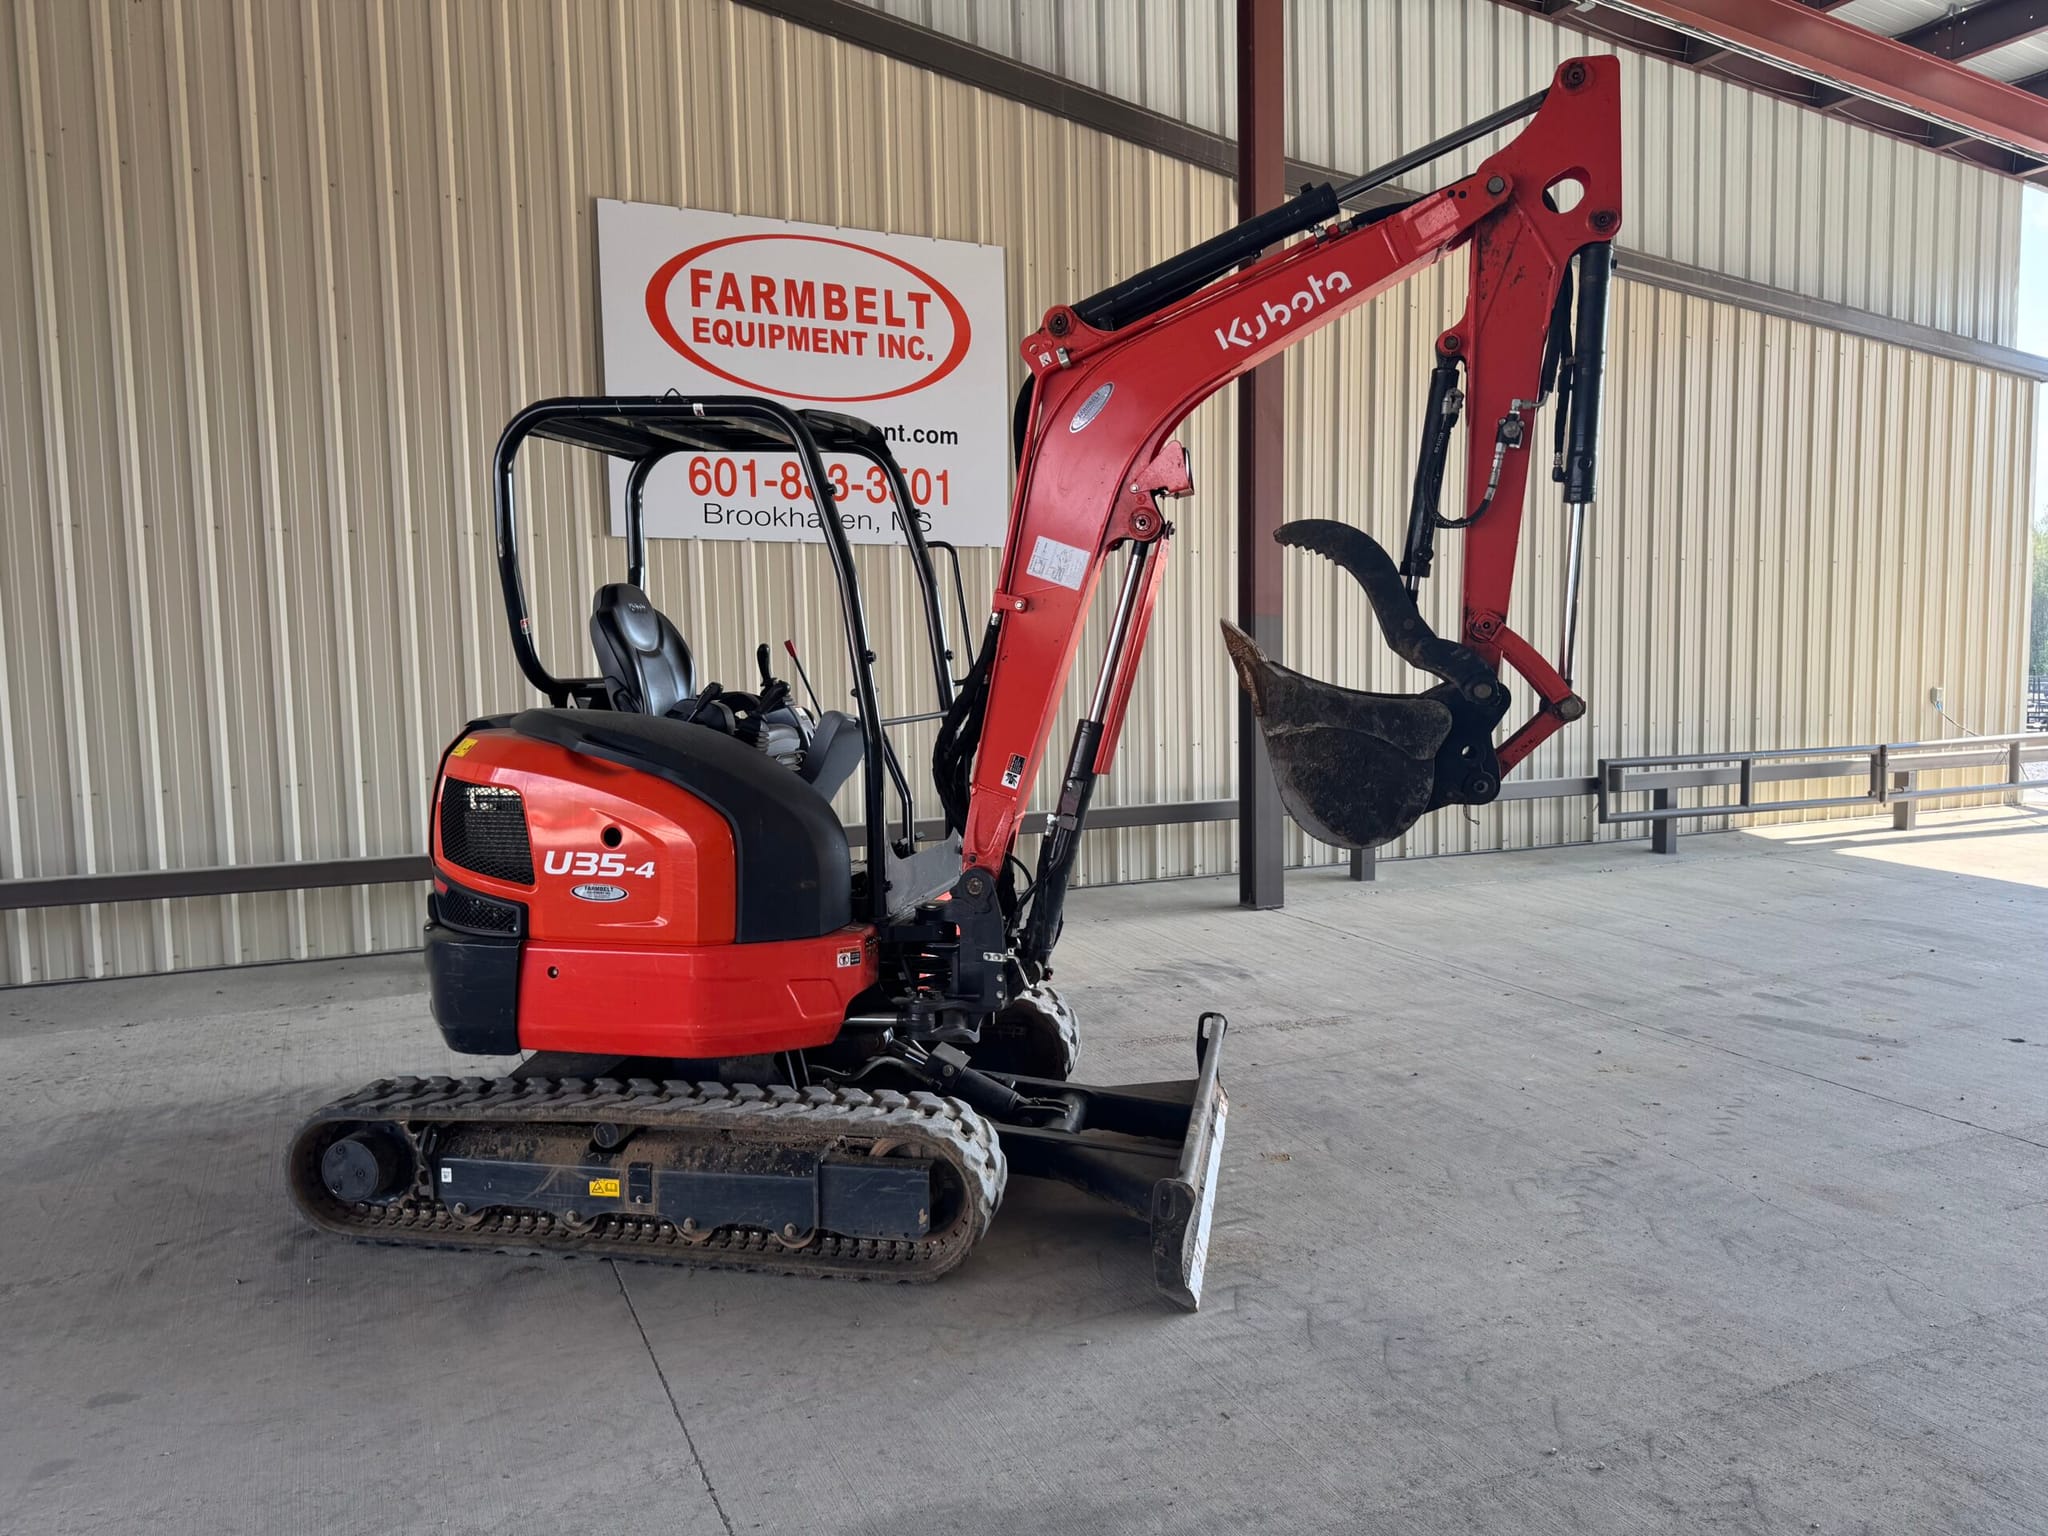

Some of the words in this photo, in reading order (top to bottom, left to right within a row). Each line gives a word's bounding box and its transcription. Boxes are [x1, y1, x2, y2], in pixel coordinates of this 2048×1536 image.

[690, 268, 932, 330] FARMBELT
[1214, 271, 1353, 351] Kubota
[692, 316, 868, 357] EQUIPMENT
[878, 332, 934, 362] INC.
[688, 455, 949, 506] 601-83-301
[703, 502, 880, 534] Brookhaen,
[543, 850, 656, 879] U35-4
